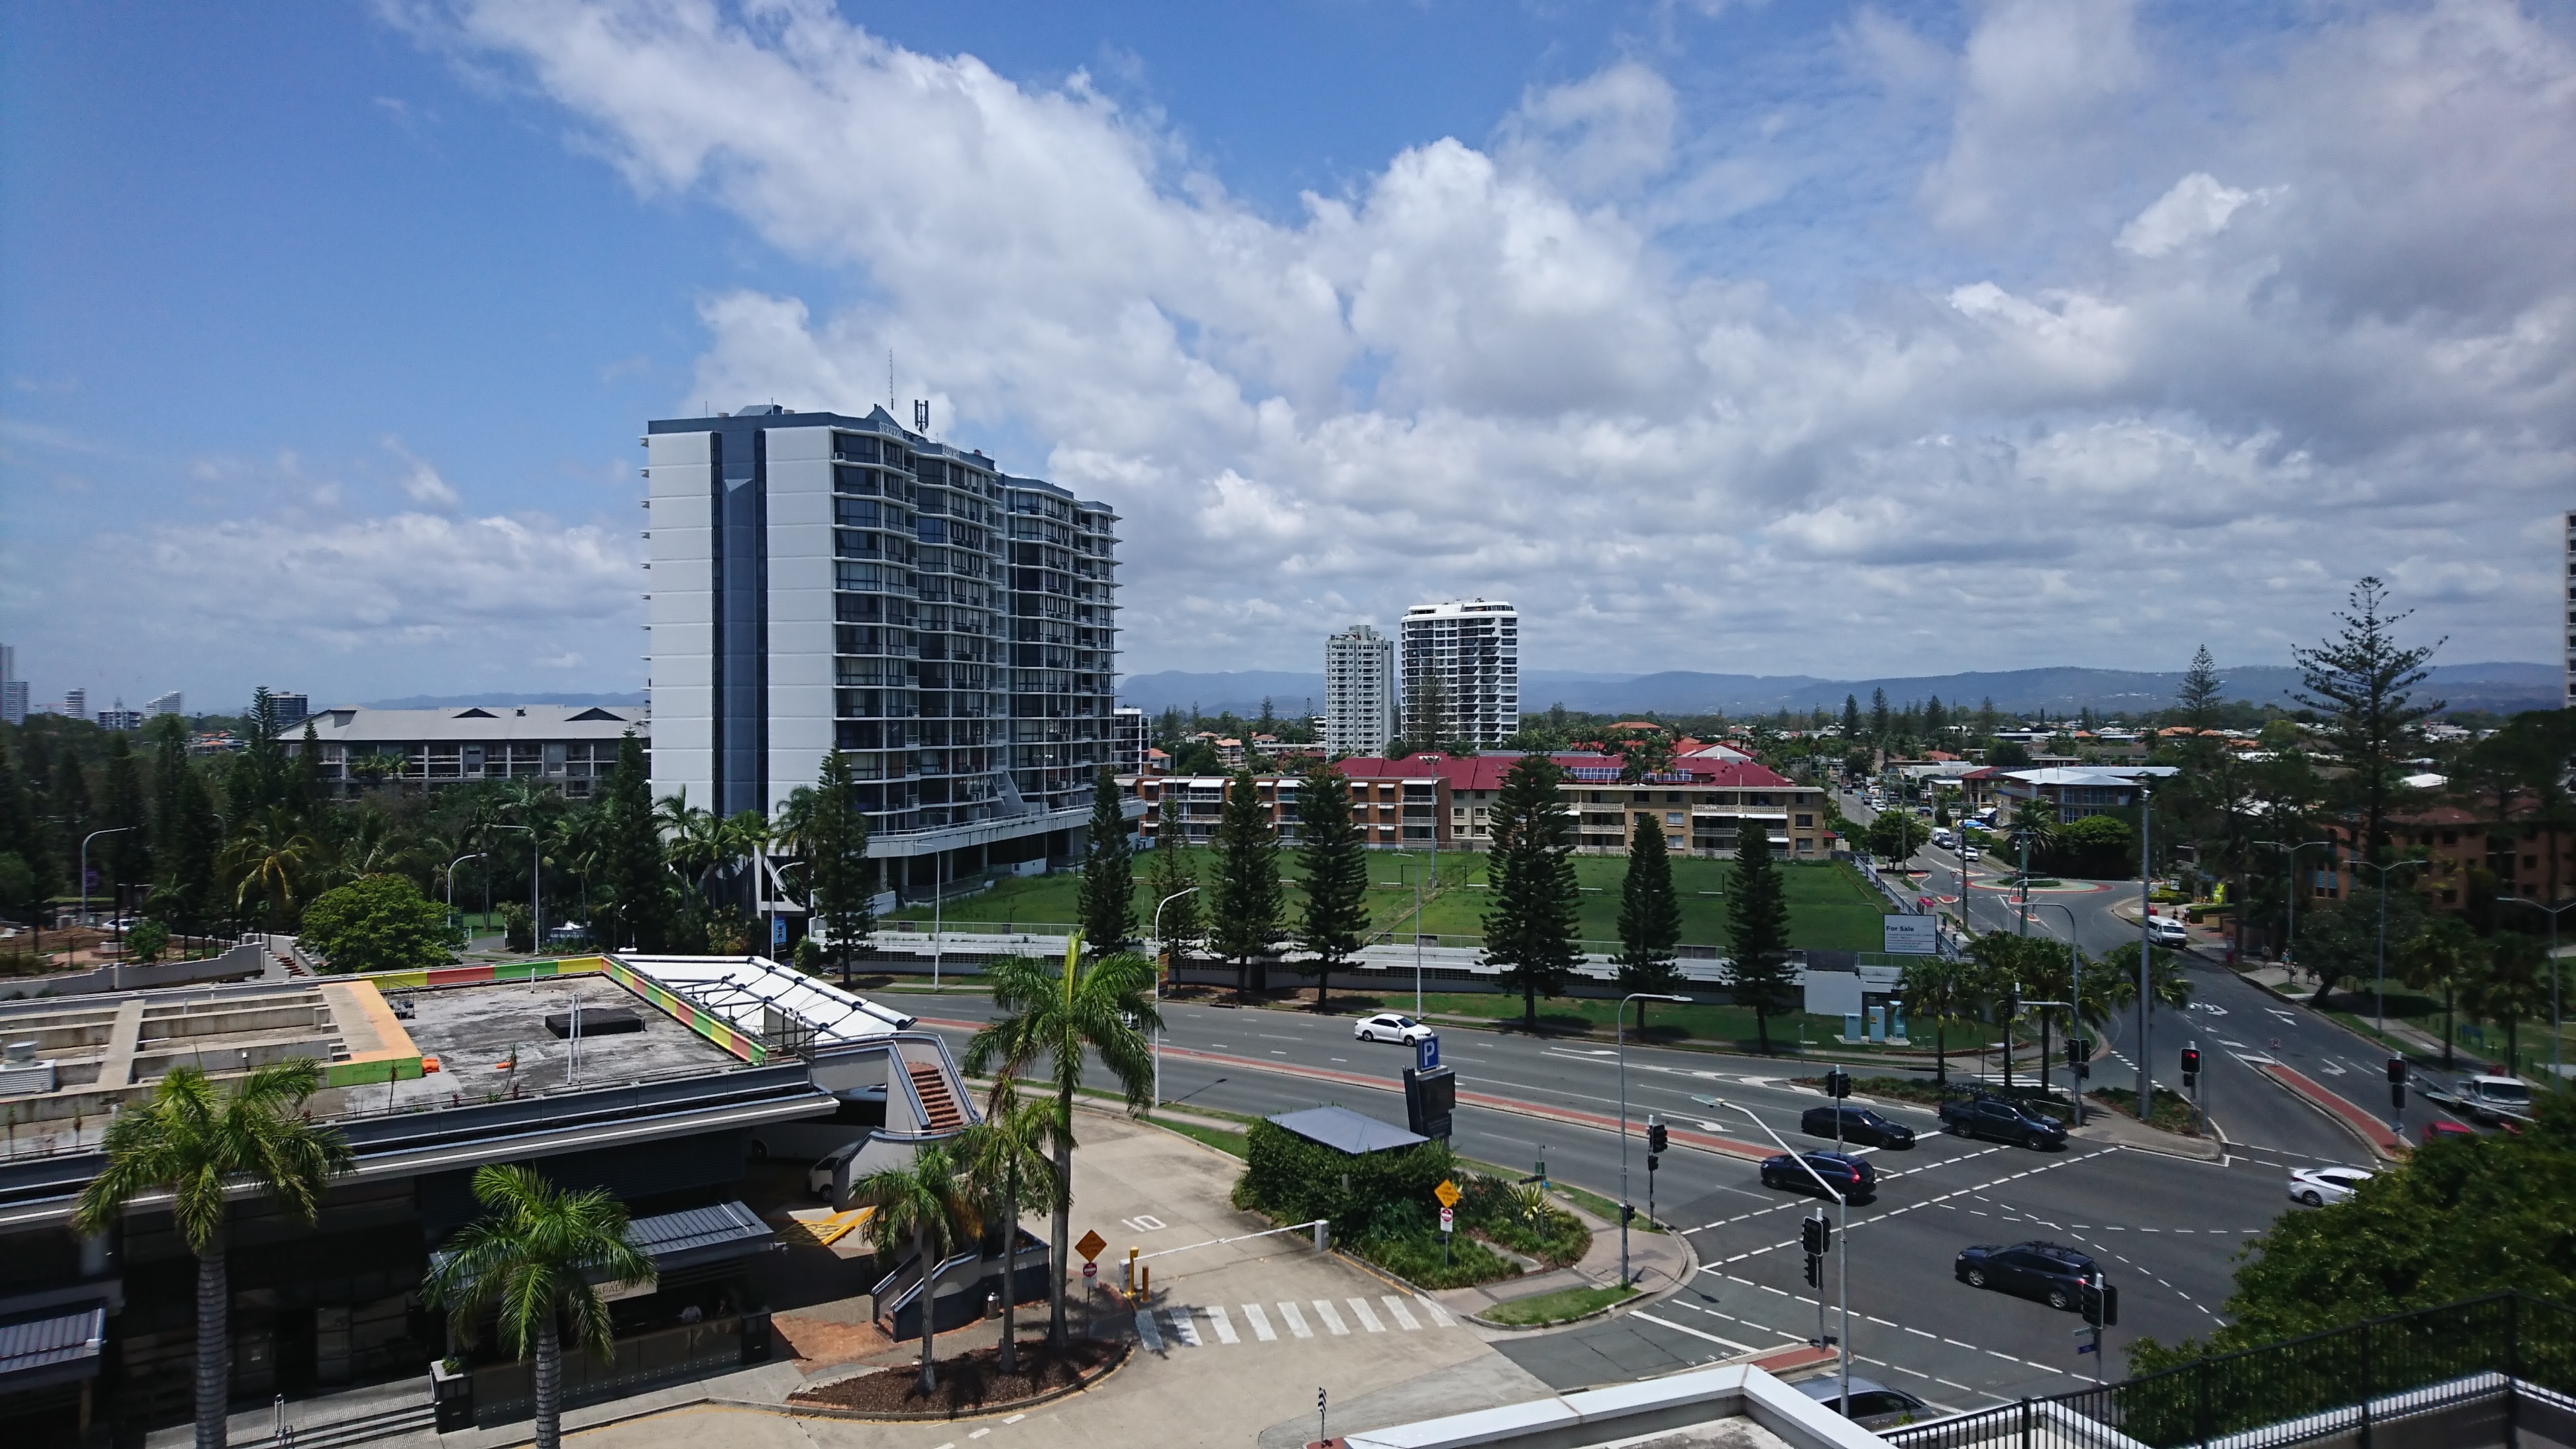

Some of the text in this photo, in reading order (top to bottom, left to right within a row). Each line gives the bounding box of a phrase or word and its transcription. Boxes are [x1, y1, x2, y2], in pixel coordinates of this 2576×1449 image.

[879, 421, 960, 460] SURFERS RESORT
[1424, 1040, 1435, 1066] P
[1121, 1215, 1167, 1232] 10
